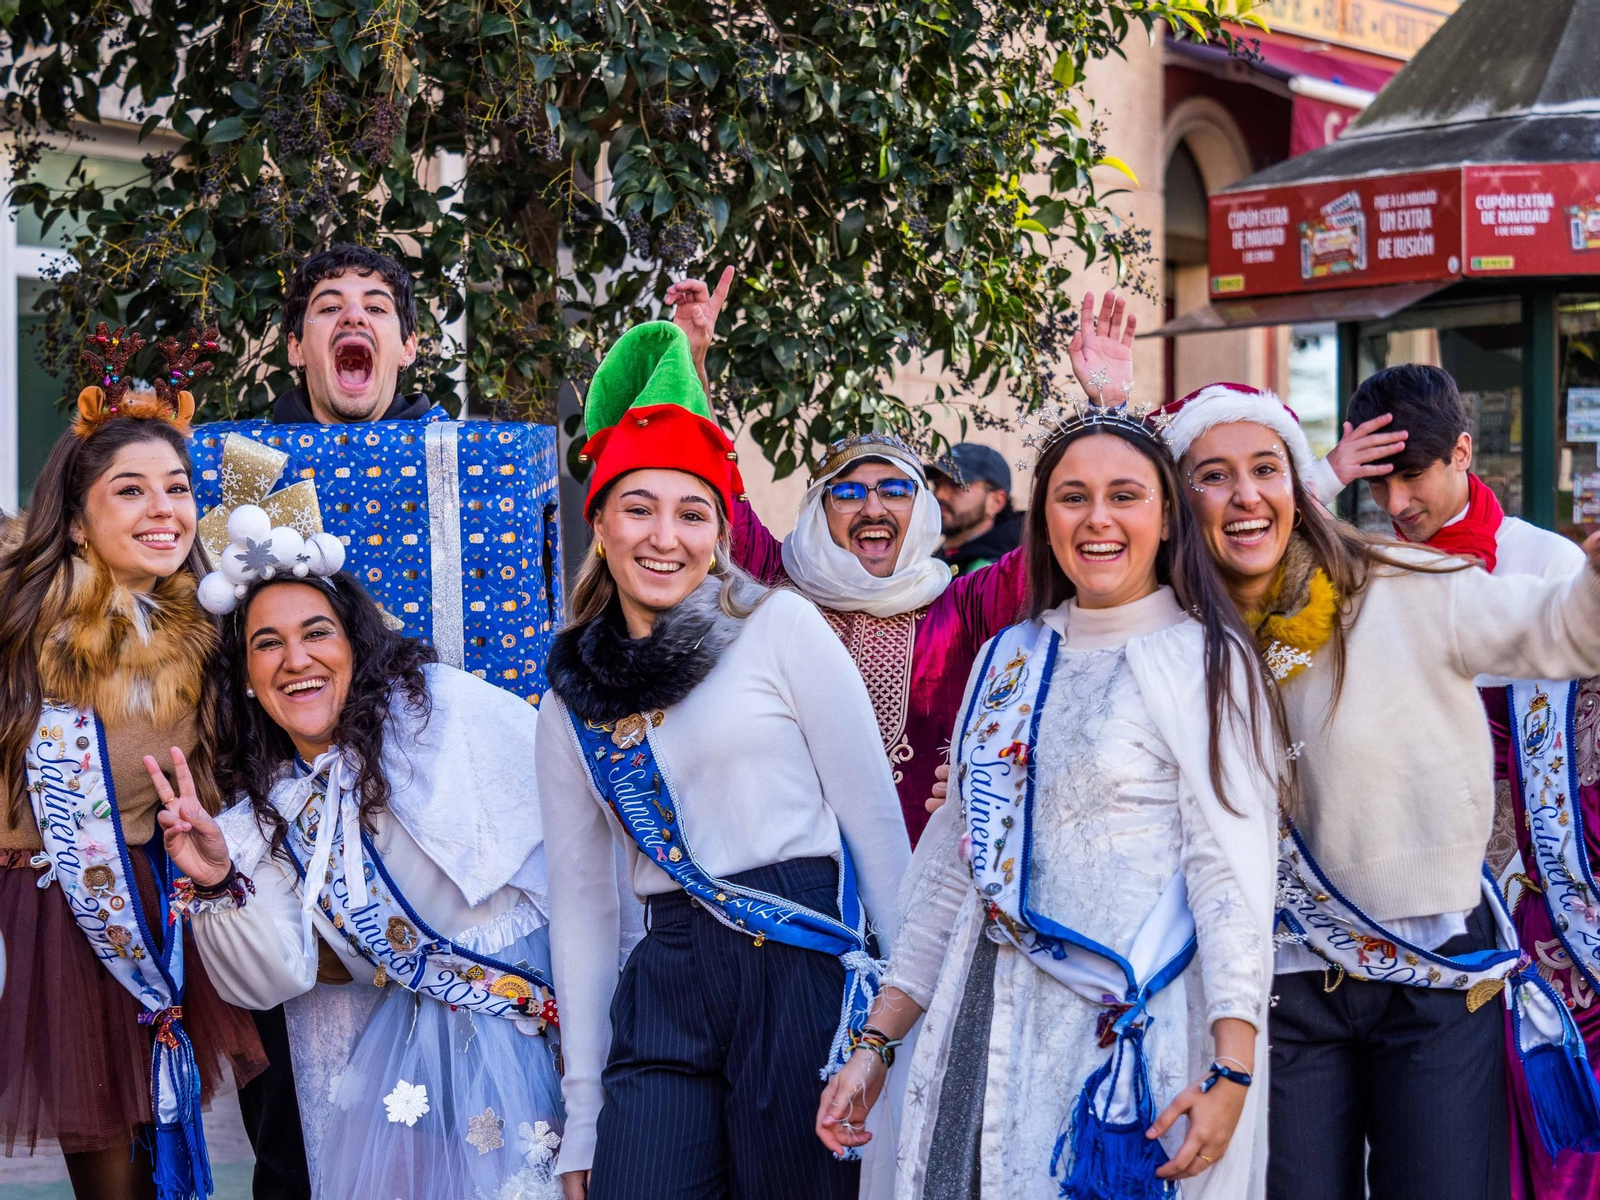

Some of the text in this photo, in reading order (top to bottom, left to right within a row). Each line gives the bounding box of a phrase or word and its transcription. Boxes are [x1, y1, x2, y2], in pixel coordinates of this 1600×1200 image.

[1475, 190, 1554, 210] CUPÓN EXTRA
[1481, 209, 1550, 225] DE NAVIDAD
[1379, 207, 1432, 232] UN EXTRA
[1377, 238, 1392, 259] DE
[1393, 231, 1435, 259] ILUSIÓN
[37, 741, 86, 876] Salinera
[608, 766, 667, 849] Salinera
[970, 744, 1011, 878] Salinera
[421, 969, 513, 1018] 2024
